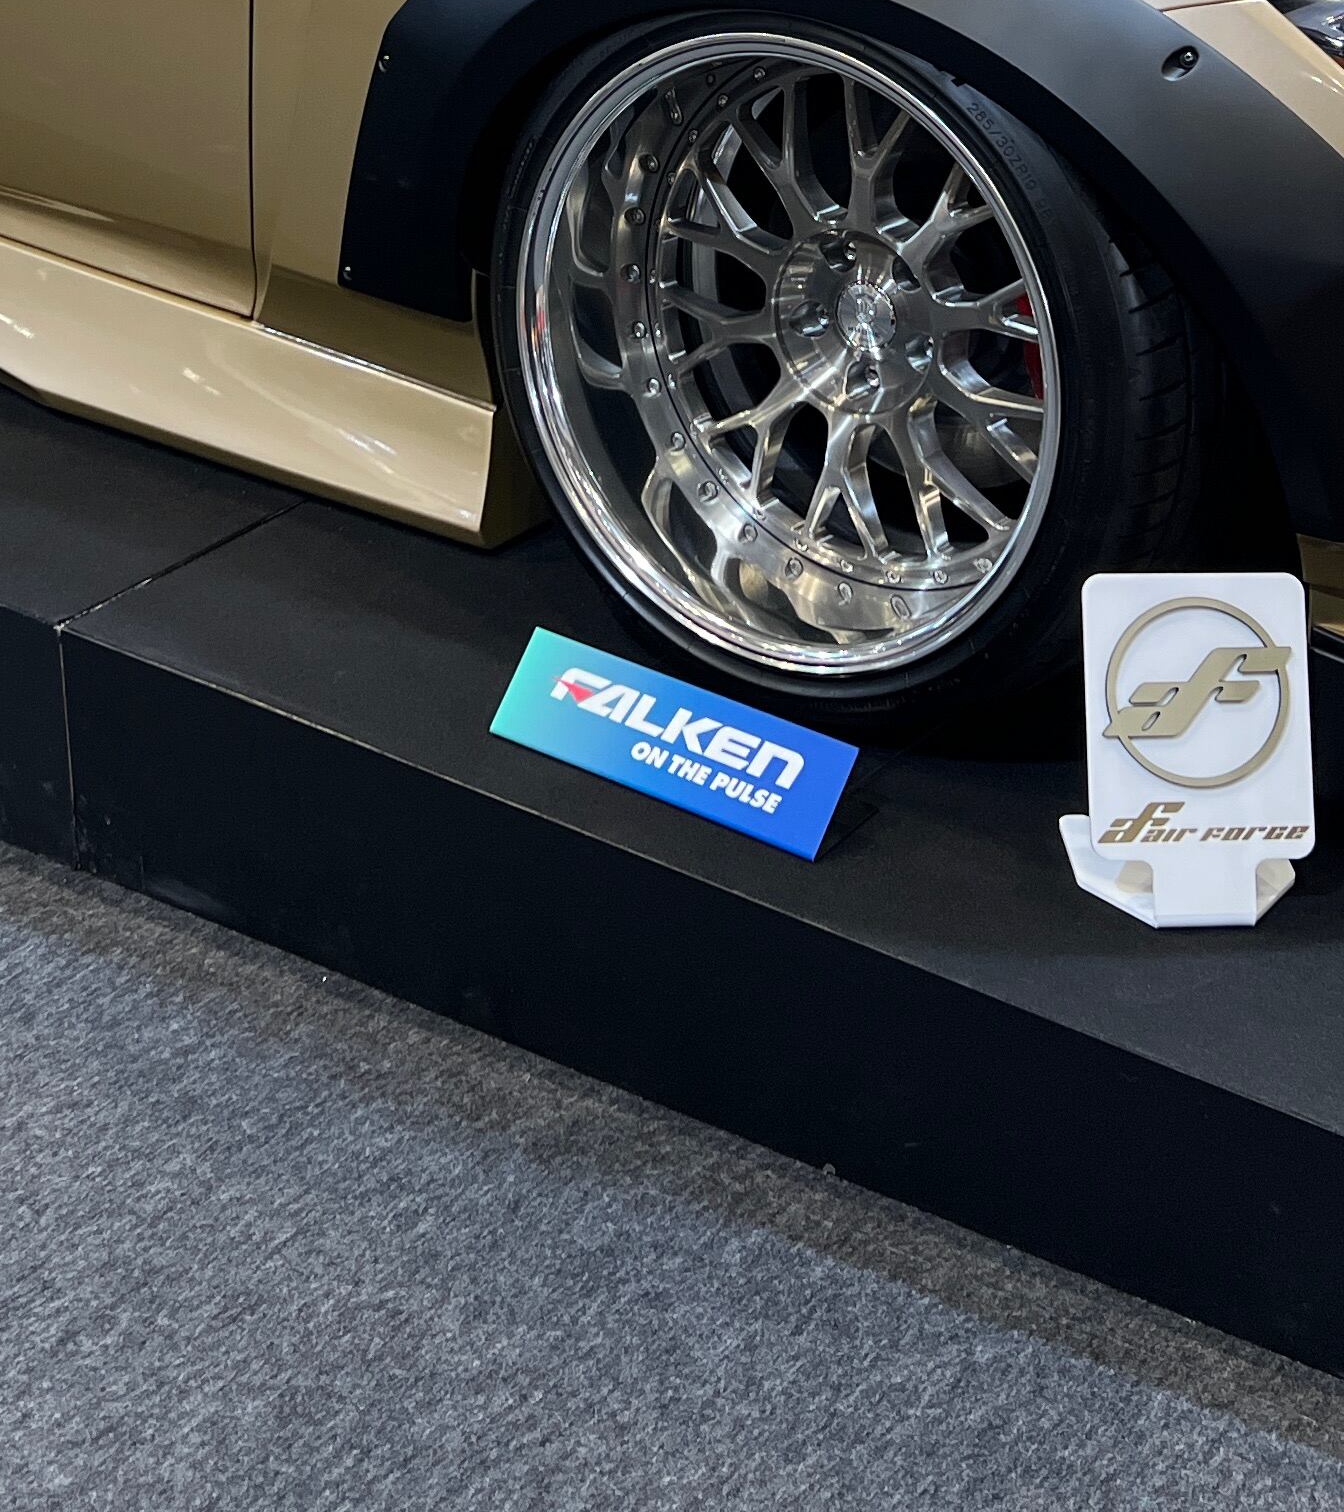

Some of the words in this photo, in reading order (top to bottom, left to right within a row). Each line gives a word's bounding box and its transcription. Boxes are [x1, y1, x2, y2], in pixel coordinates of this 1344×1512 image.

[549, 667, 805, 789] FALKEN
[630, 741, 670, 769] ON
[667, 754, 714, 786] THE
[709, 772, 783, 815] PULSE
